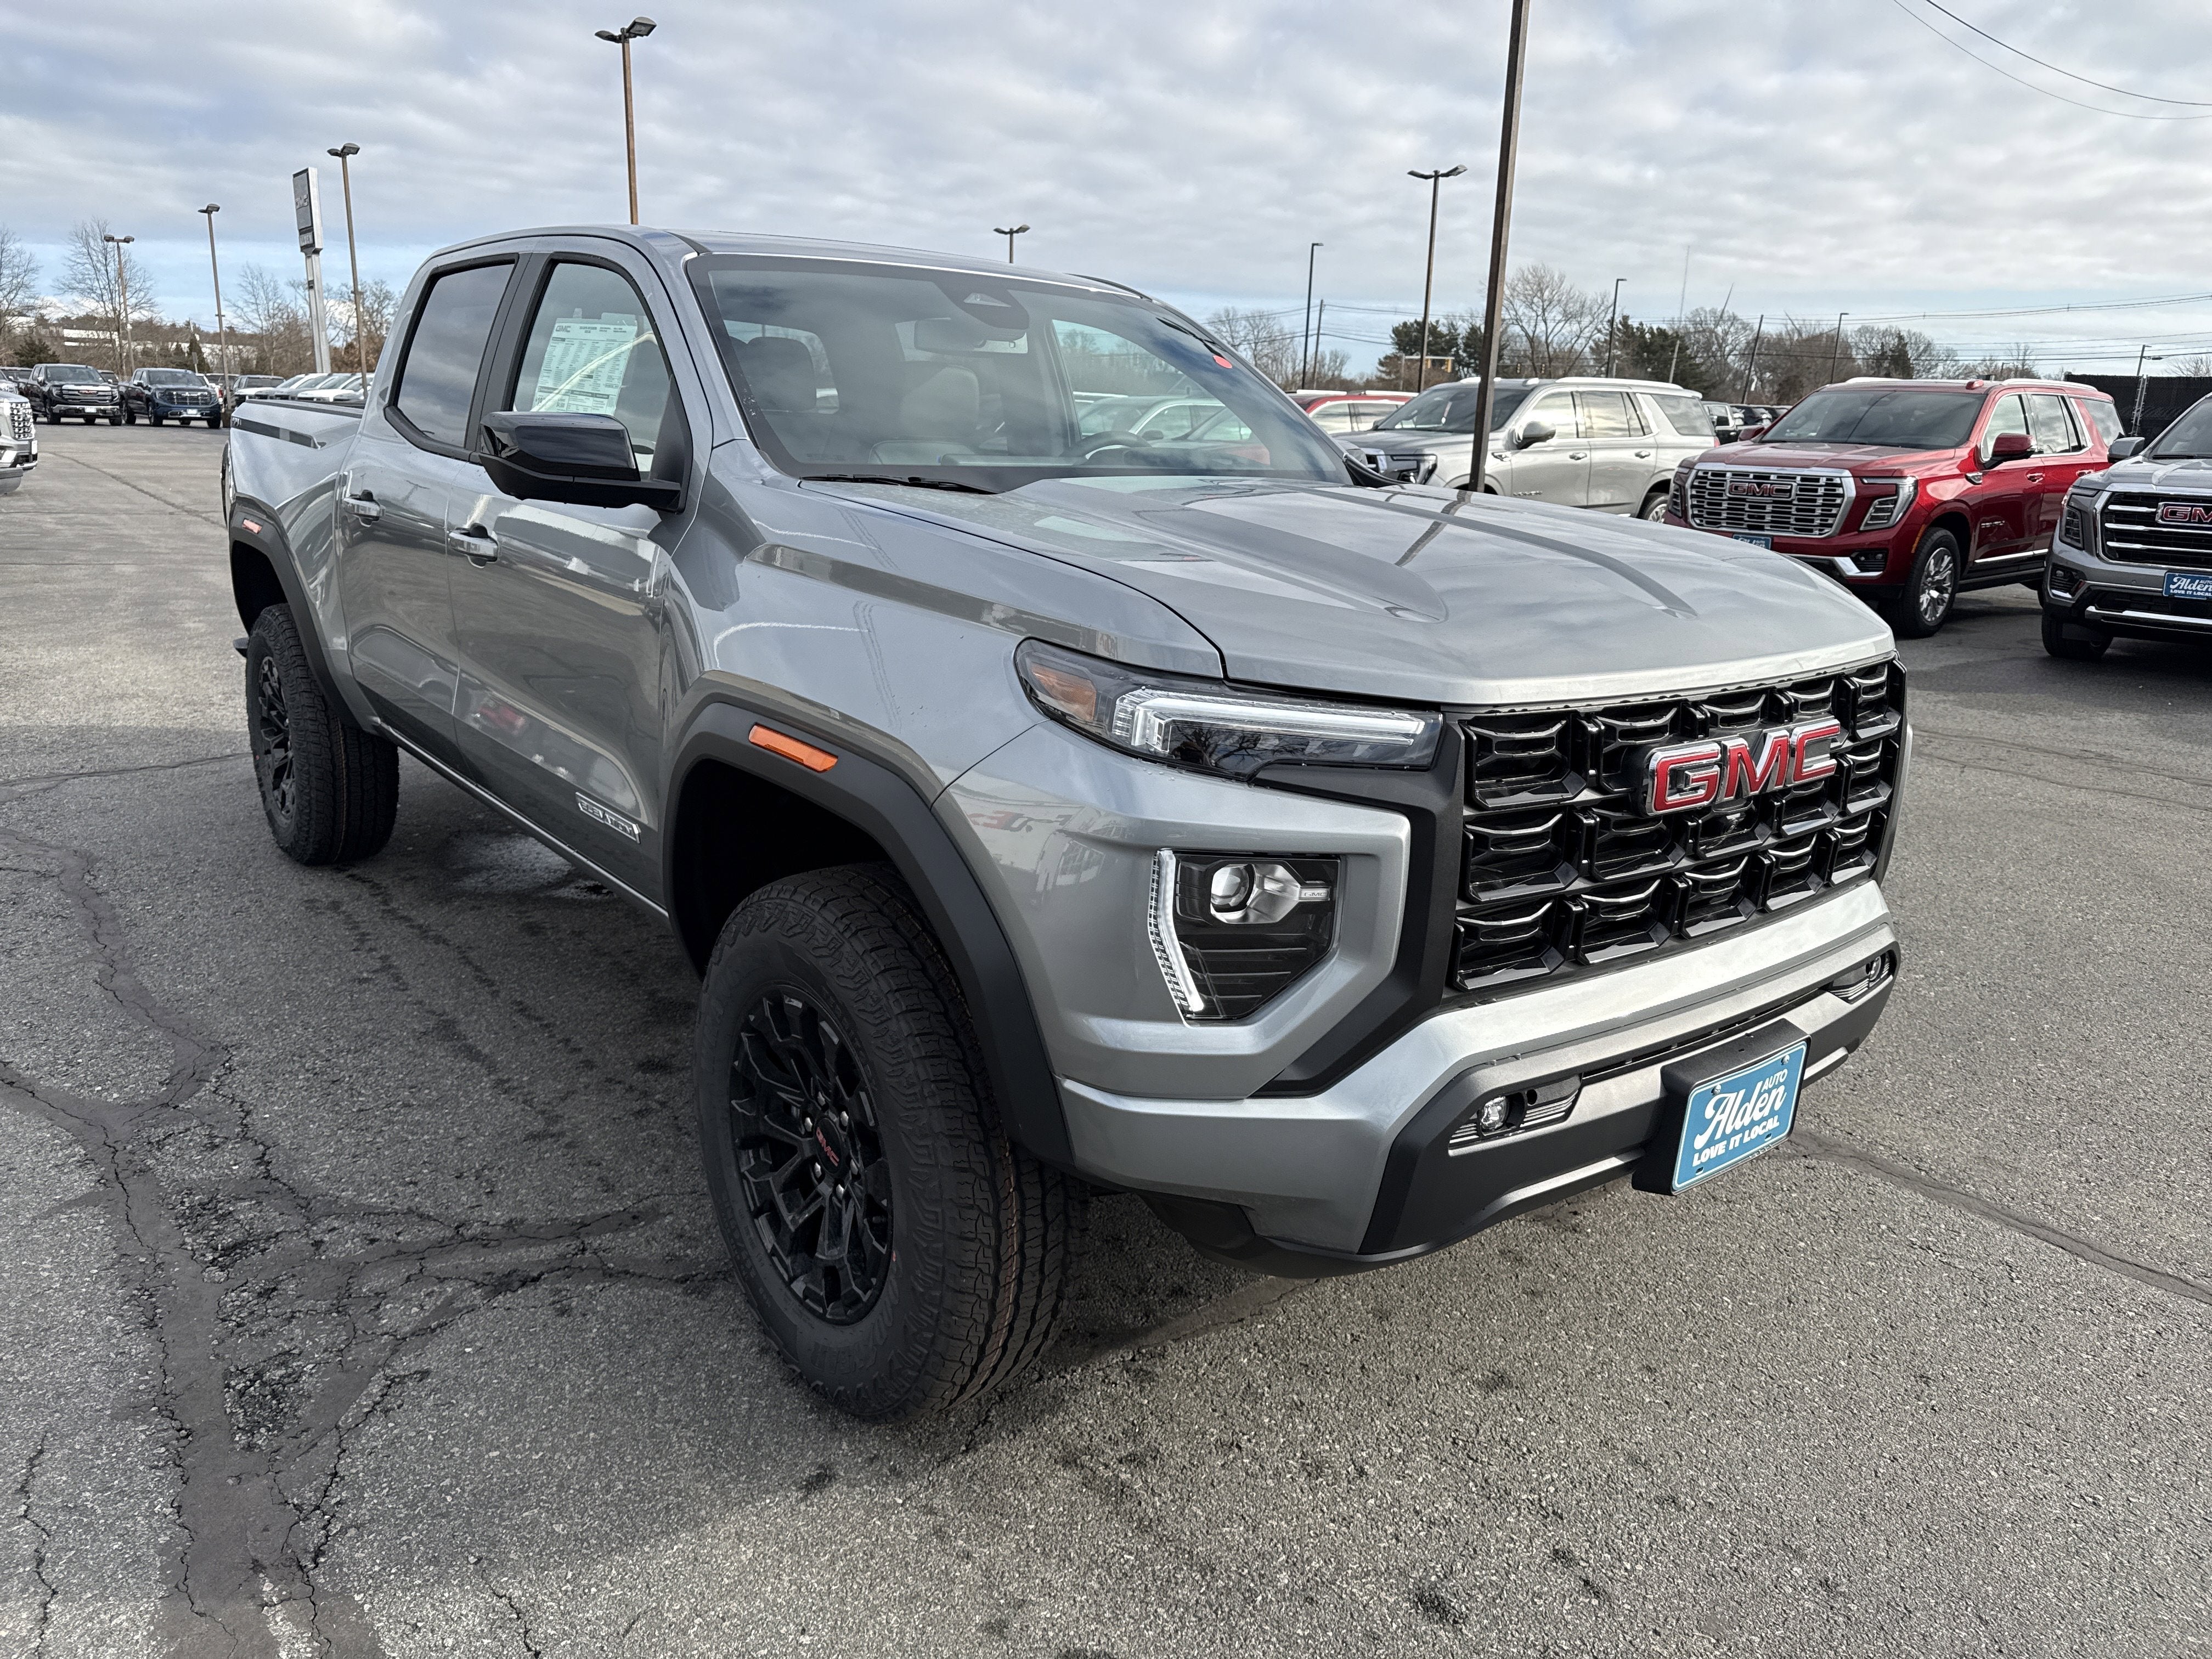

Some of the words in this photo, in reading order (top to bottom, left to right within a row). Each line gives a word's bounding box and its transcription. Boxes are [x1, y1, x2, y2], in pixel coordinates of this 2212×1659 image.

[1729, 482, 1791, 498] GMC
[2163, 505, 2212, 523] GM
[2169, 576, 2212, 592] Alden
[1646, 719, 1841, 816] GMC
[1760, 1068, 1788, 1093] AUTO
[1694, 1080, 1787, 1150] Alden
[816, 1126, 840, 1167] GMC
[1692, 1140, 1727, 1167] LOVE
[1729, 1132, 1743, 1150] IT
[1742, 1115, 1780, 1144] LOCAL
